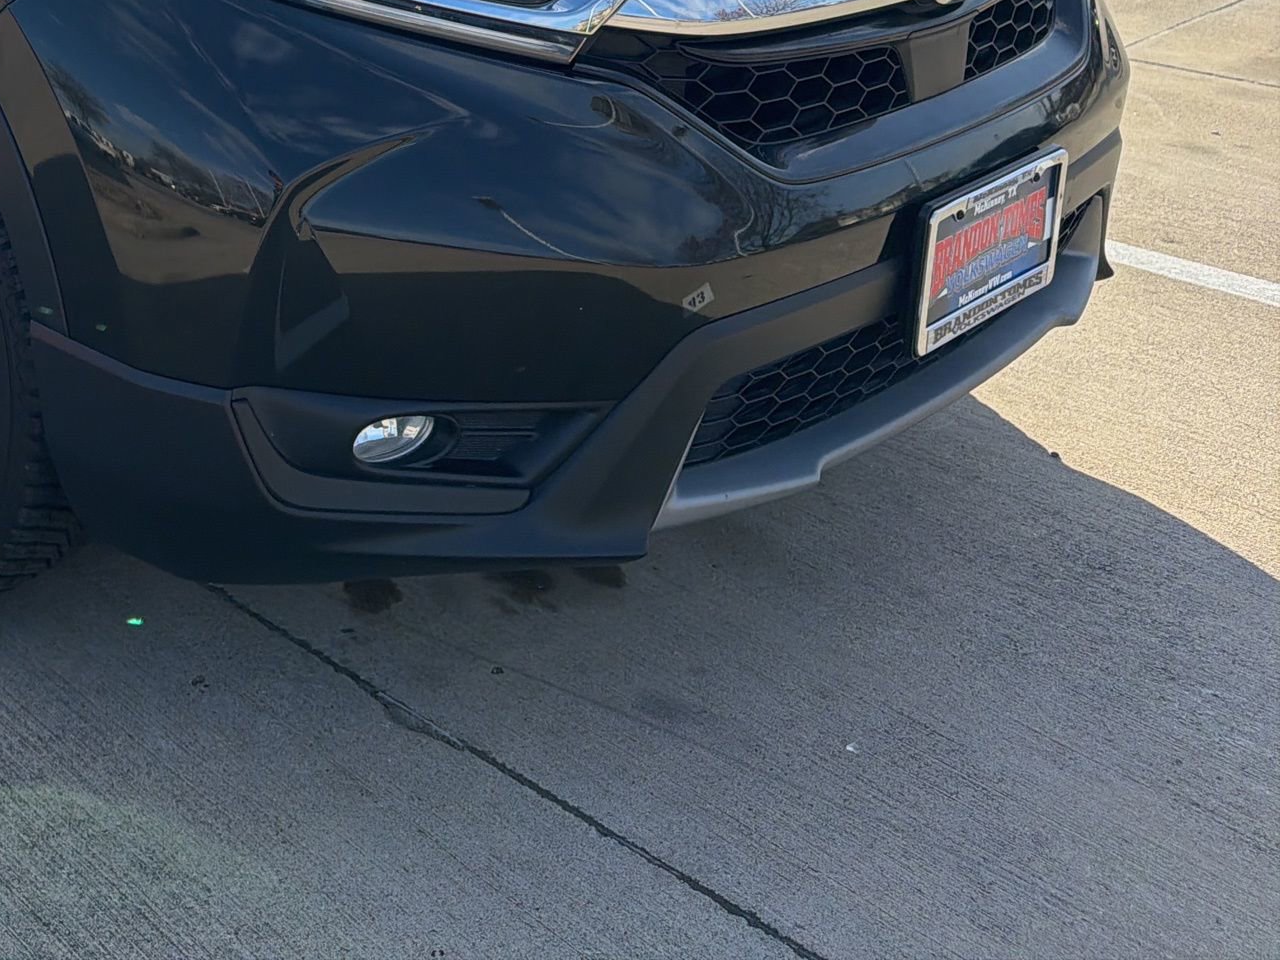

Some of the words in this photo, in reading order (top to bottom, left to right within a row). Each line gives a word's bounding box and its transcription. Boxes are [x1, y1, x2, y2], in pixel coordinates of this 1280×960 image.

[930, 212, 1000, 299] BRANDON
[946, 233, 1029, 294] VOLKSWAGEN
[687, 291, 706, 308] 43
[933, 295, 998, 343] BRANDON
[952, 288, 1026, 335] VOLKSWAGEN
